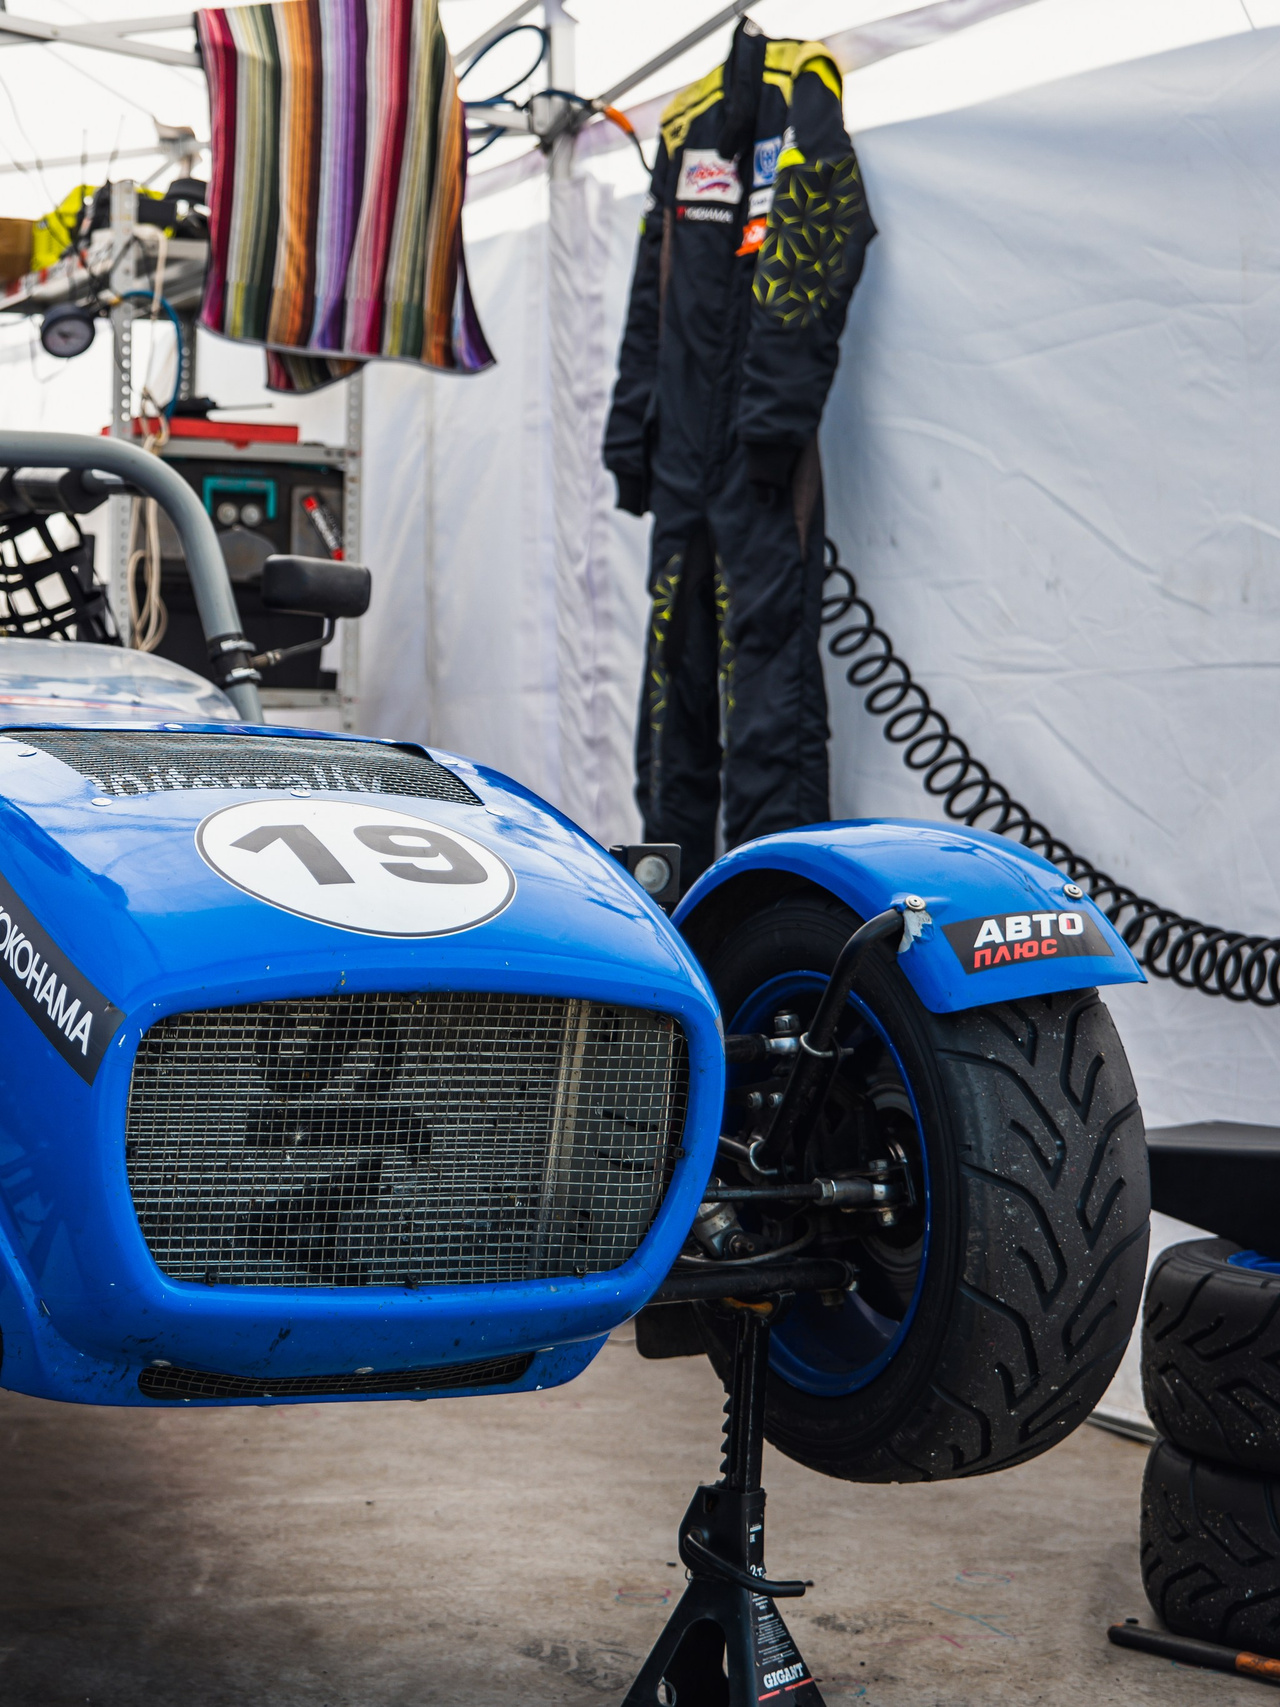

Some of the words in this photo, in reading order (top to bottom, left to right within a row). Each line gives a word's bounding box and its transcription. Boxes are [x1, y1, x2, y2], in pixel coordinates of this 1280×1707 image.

[229, 824, 489, 886] 19
[973, 912, 1084, 948] АВТО
[973, 938, 1058, 969] ПЛЮС
[762, 1661, 805, 1689] GIGANT
